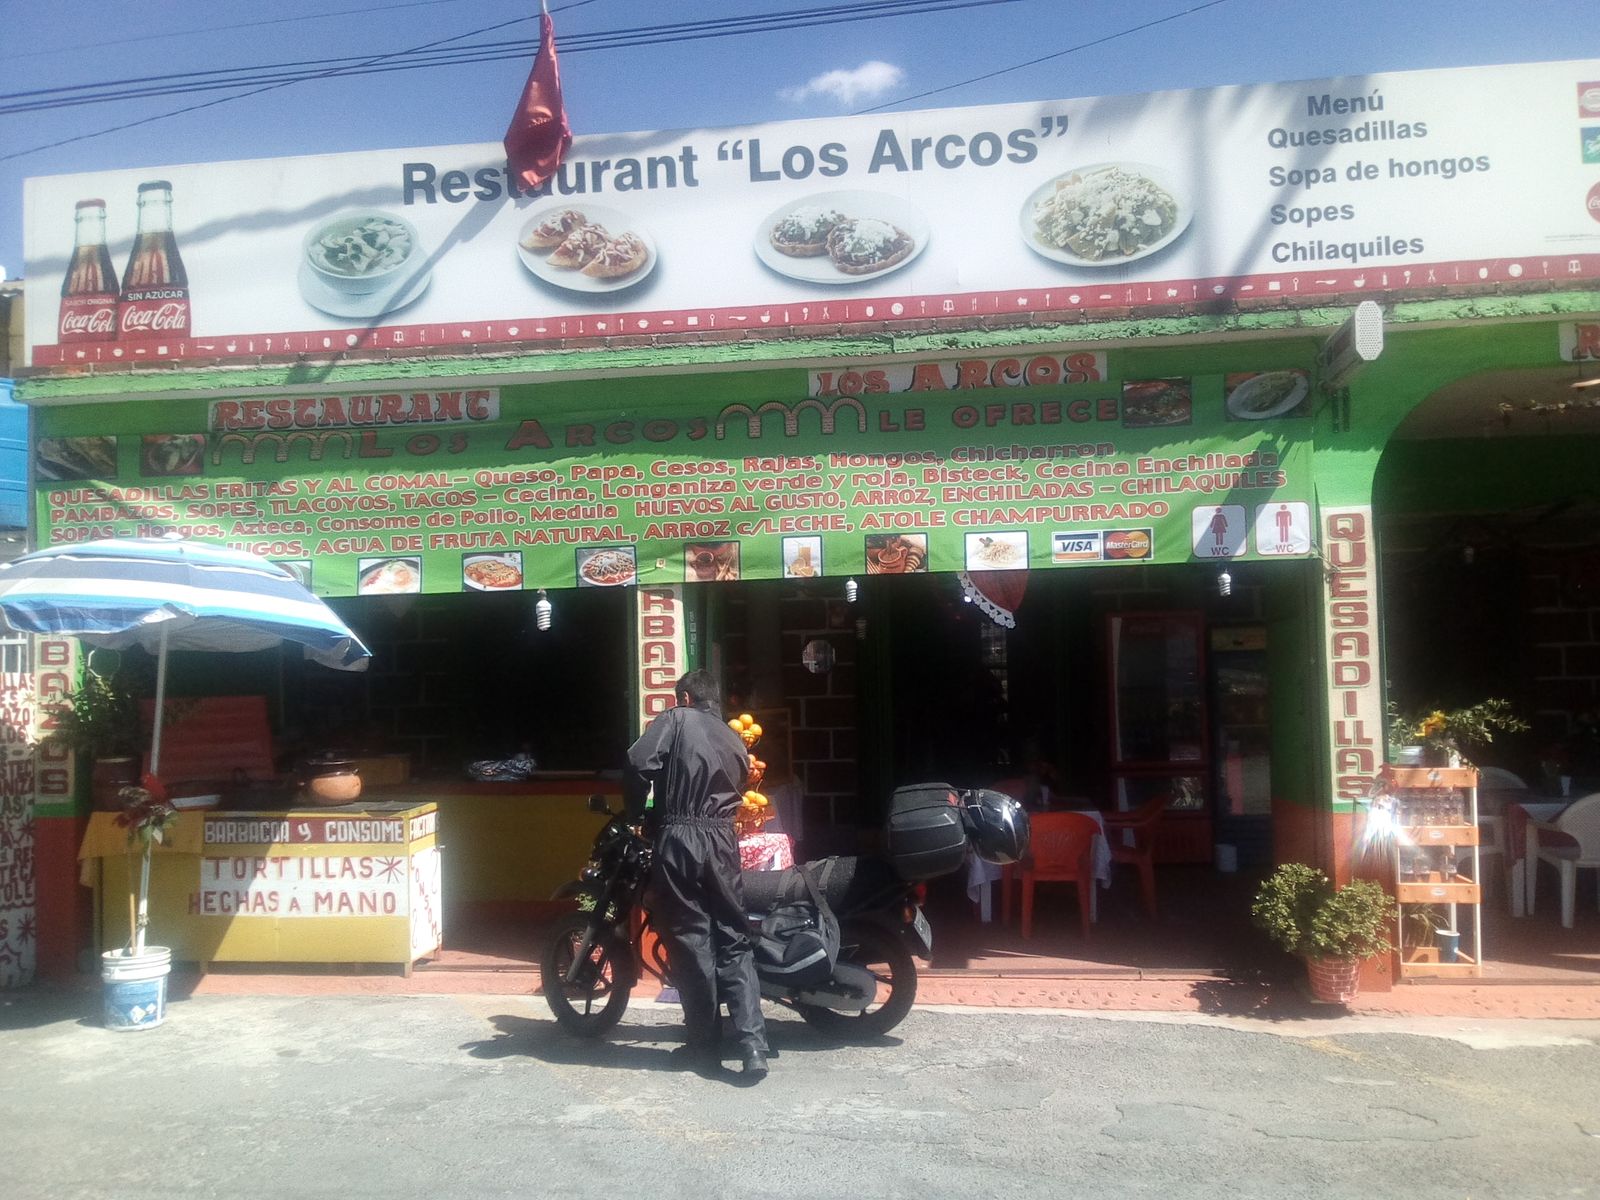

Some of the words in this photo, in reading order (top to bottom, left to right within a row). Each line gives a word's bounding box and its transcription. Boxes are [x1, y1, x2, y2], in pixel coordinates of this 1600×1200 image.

[1307, 89, 1384, 116] Menú
[1267, 120, 1428, 150] Quesadillas
[1268, 163, 1337, 189] Sopa
[1346, 160, 1379, 181] de
[1388, 155, 1491, 180] hongos
[1270, 204, 1355, 227] Sopes
[1271, 236, 1425, 263] Chilaquiles
[128, 293, 142, 301] SIN
[61, 309, 116, 335] Coca-Cola
[122, 303, 187, 332] Coca-Cola
[815, 370, 890, 396] LOS
[905, 352, 1102, 392] ARCOS
[213, 390, 490, 431] RESTAURANT
[879, 408, 926, 432] LE
[952, 399, 1119, 428] OFRECE
[50, 484, 210, 507] QUESADILLAS
[214, 479, 299, 500] FRITAS
[304, 479, 322, 495] Y
[327, 478, 359, 494] AL
[474, 469, 565, 488] Queso,
[570, 465, 644, 482] Papa,
[650, 460, 736, 477] Cesos,
[742, 454, 823, 473] Rajas,
[829, 452, 944, 468] Hongos,
[951, 442, 1116, 463] Chicharron
[50, 502, 181, 524] PAMBAZOS,
[186, 500, 264, 519] SOPES,
[269, 494, 396, 516] TLACOYOS,
[401, 490, 478, 509] TACOS
[503, 485, 596, 503] Cecina,
[602, 478, 738, 498] Longaniza
[742, 473, 824, 492] verde
[828, 473, 847, 489] y
[851, 470, 917, 488] roja,
[923, 464, 1030, 484] Bisteck,
[1035, 461, 1130, 479] Cecina
[1136, 450, 1279, 475] Enchilada
[50, 525, 115, 543] SOPAS
[136, 523, 226, 539] Hongos,
[230, 519, 314, 535] Azteca,
[316, 513, 421, 532] Consome
[426, 511, 456, 526] de
[460, 508, 526, 526] Pollo,
[530, 503, 619, 522] Medula
[635, 498, 726, 517] HUEVOS
[729, 496, 761, 513] AL
[764, 491, 847, 510] GUSTO,
[851, 487, 937, 506] ARROZ,
[942, 482, 1095, 503] ENCHILADAS
[1120, 470, 1288, 496] CHILAQUILES
[315, 536, 387, 555] AGUA
[391, 535, 423, 552] DE
[430, 531, 508, 549] FRUTA
[513, 525, 639, 547] NATURAL,
[643, 519, 732, 541] ARROZ
[736, 514, 854, 536] c/LECHE,
[860, 511, 946, 530] ATOLE
[952, 500, 1170, 526] CHAMPURRADO
[1062, 541, 1093, 552] VISA
[1106, 540, 1149, 549] MasterCard
[1211, 546, 1229, 556] WC
[1275, 544, 1295, 553] WC
[1326, 512, 1376, 801] QUESADILLAS
[205, 820, 290, 843] BARBACOA
[325, 820, 404, 843] CONSOME
[205, 856, 373, 880] TORTILLAS
[188, 890, 279, 915] HECHAS
[314, 891, 396, 914] MANO
